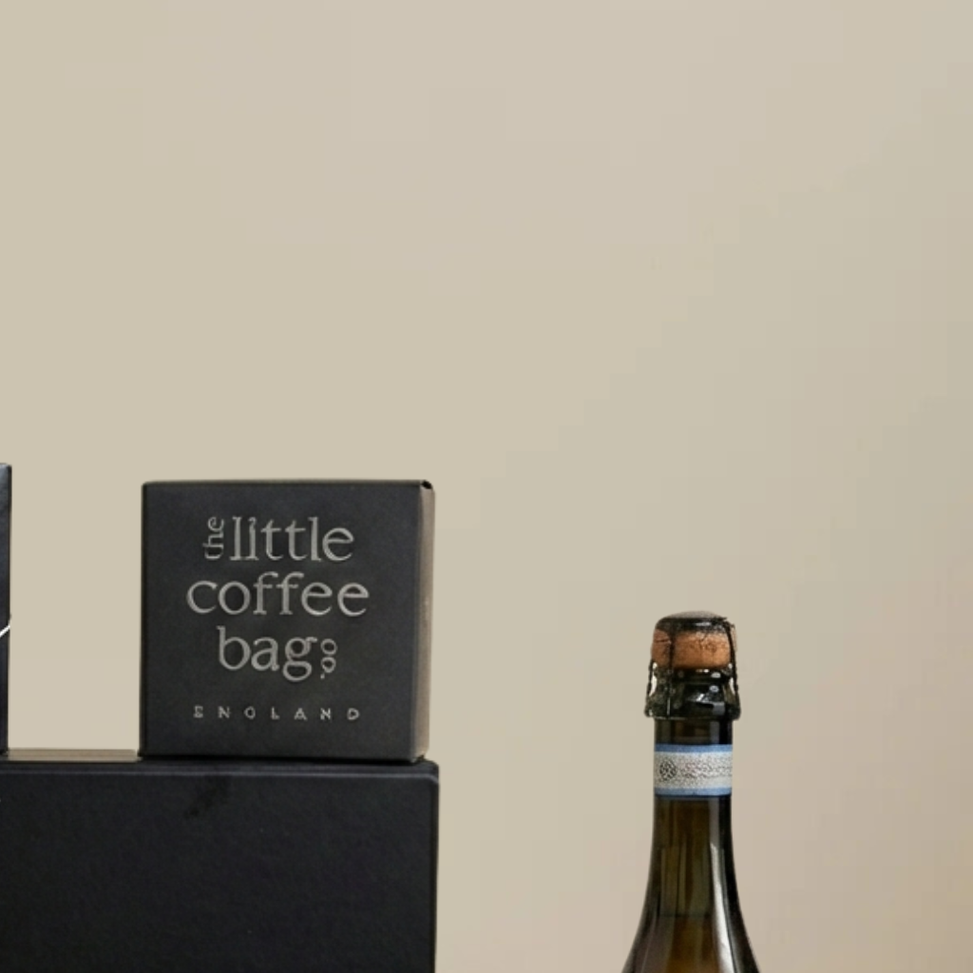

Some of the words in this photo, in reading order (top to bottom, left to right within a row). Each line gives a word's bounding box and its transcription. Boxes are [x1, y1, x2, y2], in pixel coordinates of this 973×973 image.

[202, 516, 225, 560] the
[230, 516, 355, 561] little
[187, 571, 370, 616] coffee
[216, 625, 318, 682] bag
